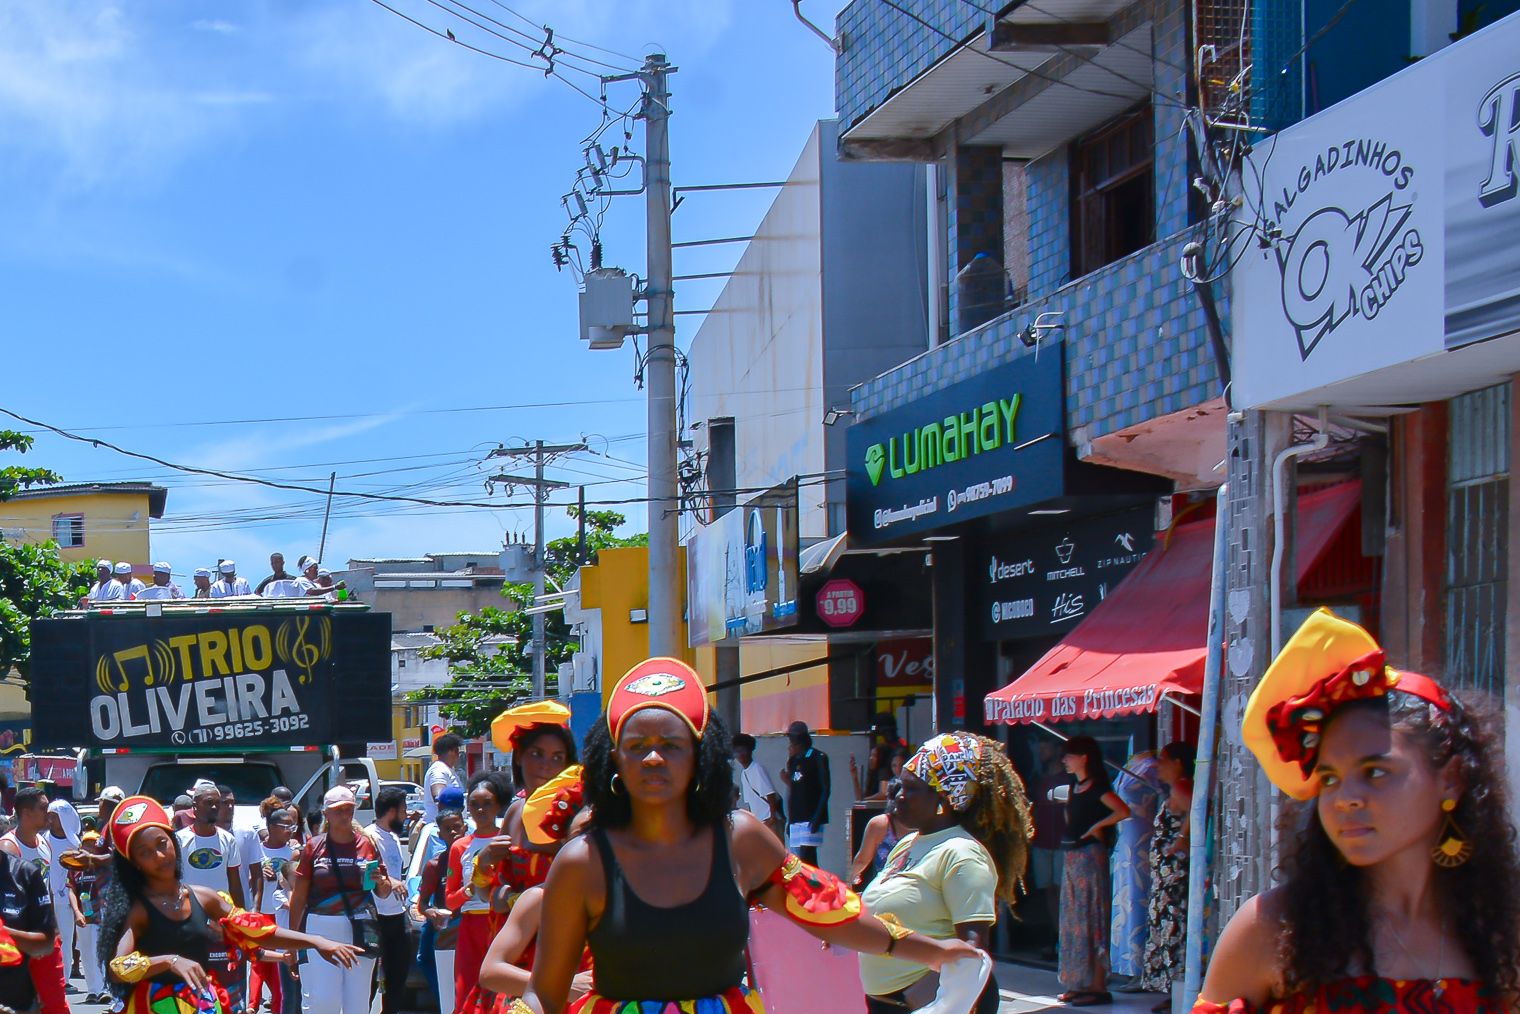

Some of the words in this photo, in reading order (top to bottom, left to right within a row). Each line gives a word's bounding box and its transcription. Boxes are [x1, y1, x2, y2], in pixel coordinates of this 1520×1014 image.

[1266, 138, 1415, 229] ALGADINHOS
[1359, 228, 1424, 320] CHIPS
[997, 559, 1035, 580] desert
[1046, 566, 1086, 581] MITCHELL
[1097, 558, 1112, 569] ZIP
[824, 597, 857, 616] 9,99
[168, 624, 273, 681] TRIO
[89, 669, 302, 742] OLIVEIRA
[993, 692, 1045, 720] Palácio
[1051, 691, 1077, 717] das
[1082, 683, 1157, 714] Princesas
[188, 727, 213, 744] (71)
[214, 714, 310, 741] 99625-3092
